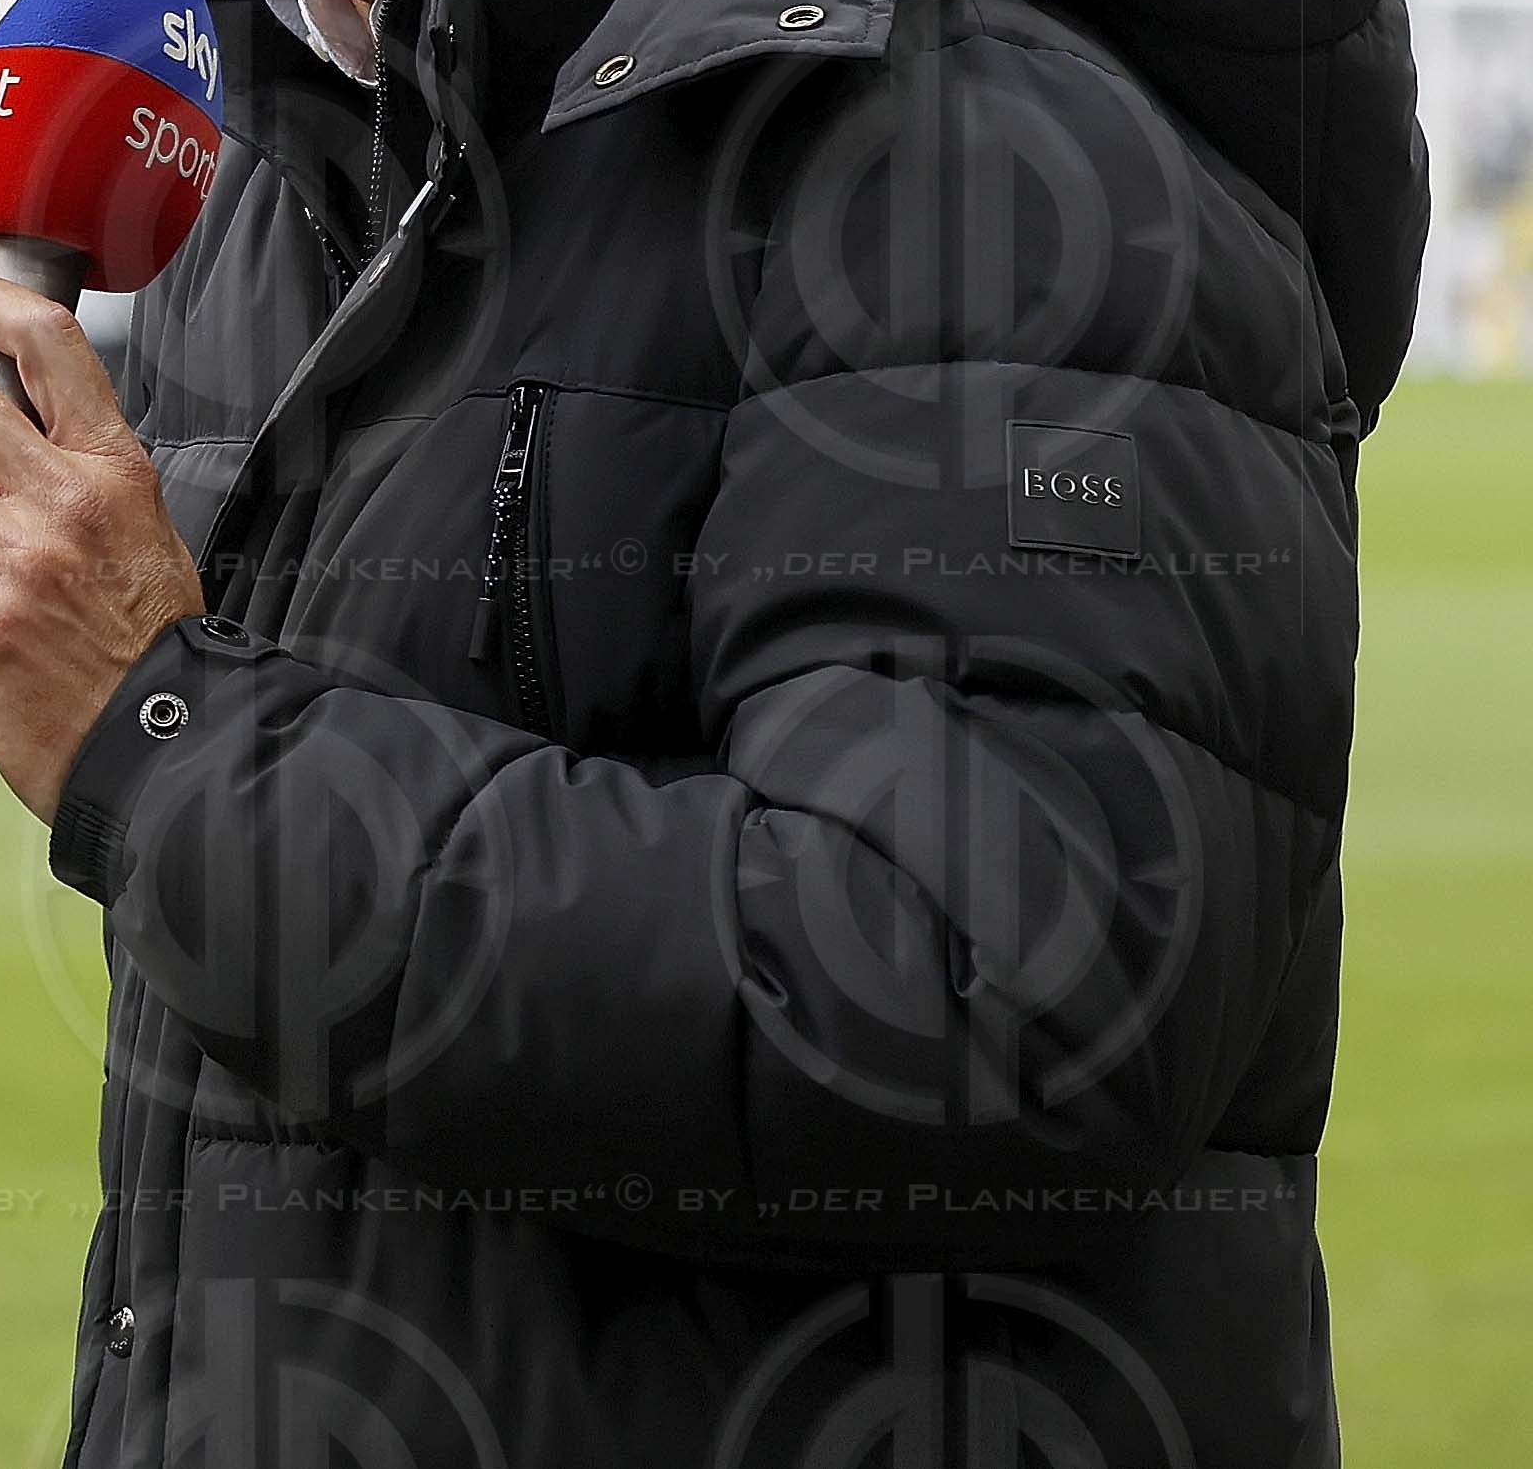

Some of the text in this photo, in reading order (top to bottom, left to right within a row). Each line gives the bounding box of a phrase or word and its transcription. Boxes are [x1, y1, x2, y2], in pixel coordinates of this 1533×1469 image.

[162, 8, 219, 101] sky
[125, 107, 216, 202] sport
[1023, 467, 1125, 508] BOSS
